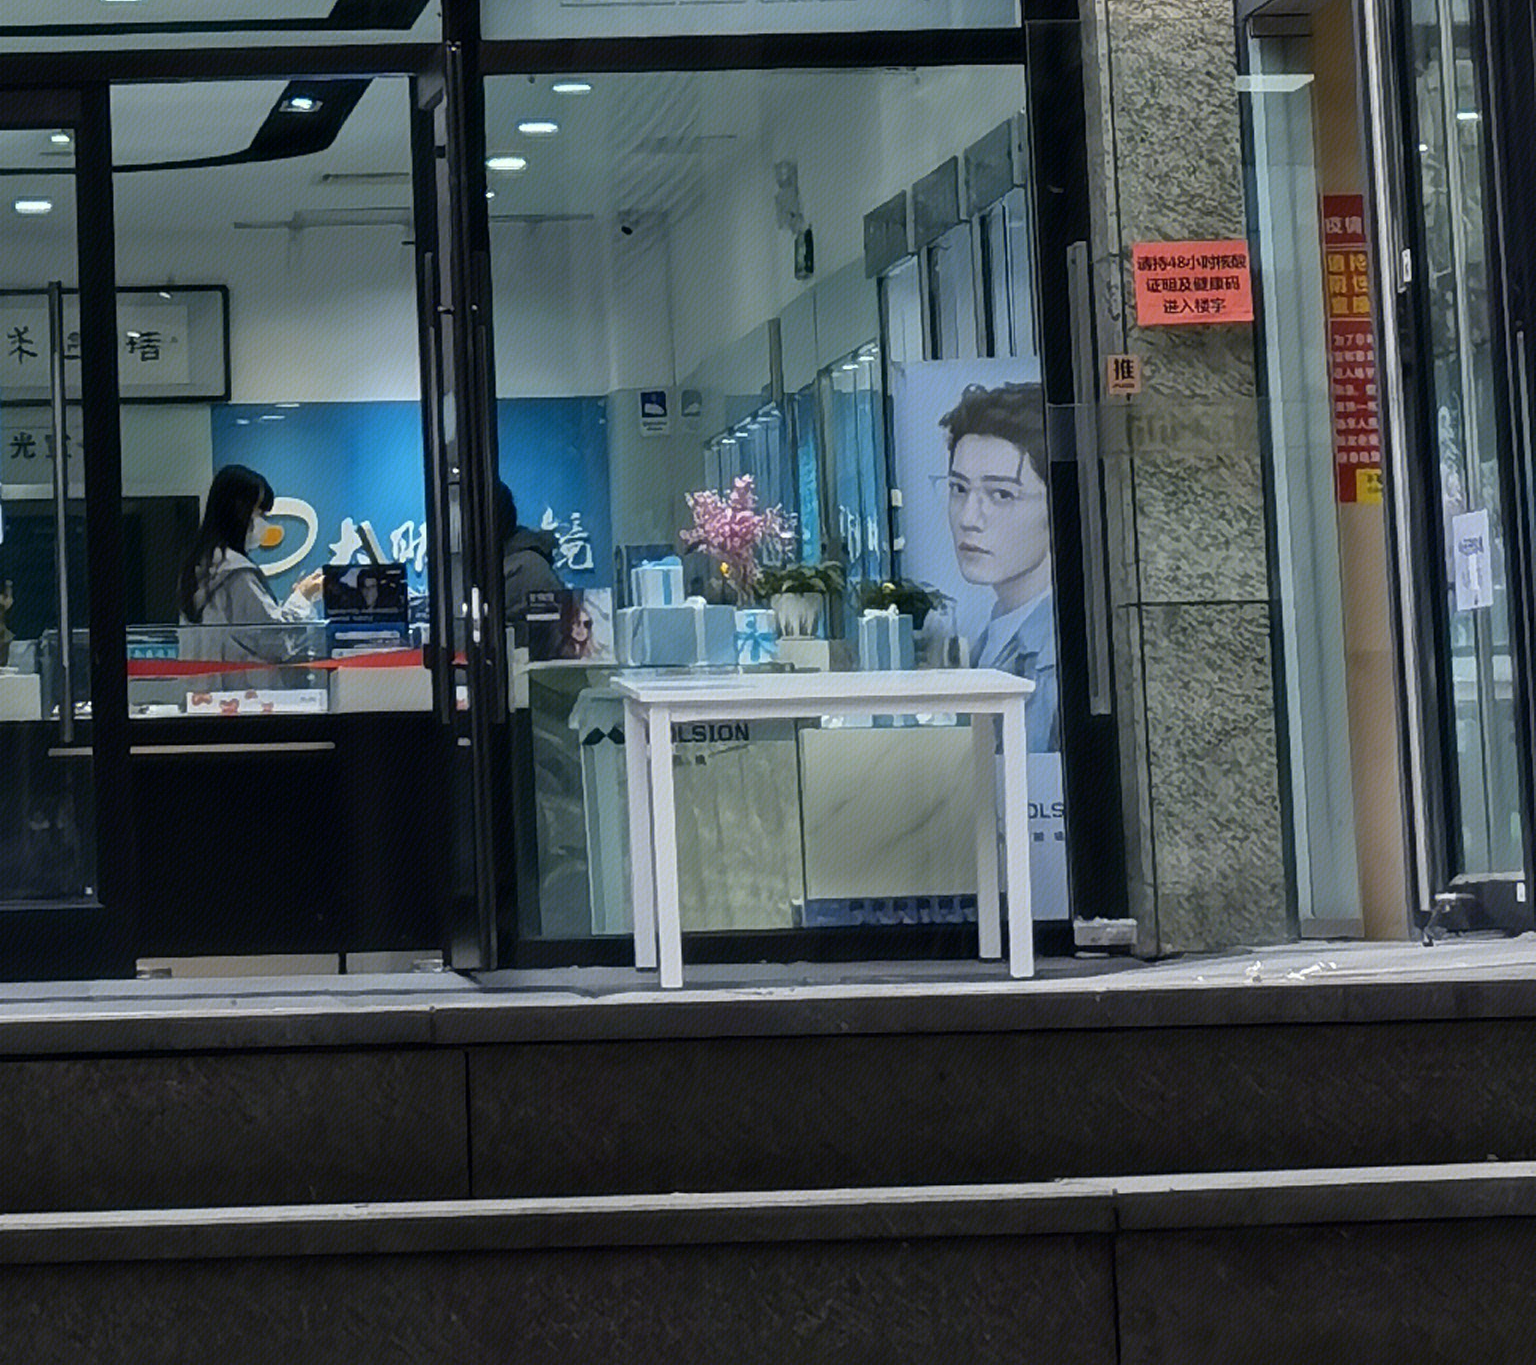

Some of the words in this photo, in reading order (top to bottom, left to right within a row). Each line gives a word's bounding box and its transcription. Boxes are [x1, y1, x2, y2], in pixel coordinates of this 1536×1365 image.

[1137, 254, 1247, 272] 请持48小时核酸
[1146, 275, 1241, 293] 证明及健康码
[1163, 298, 1227, 314] 进入楼宇
[1114, 357, 1135, 381] 推
[671, 723, 750, 744] LSION
